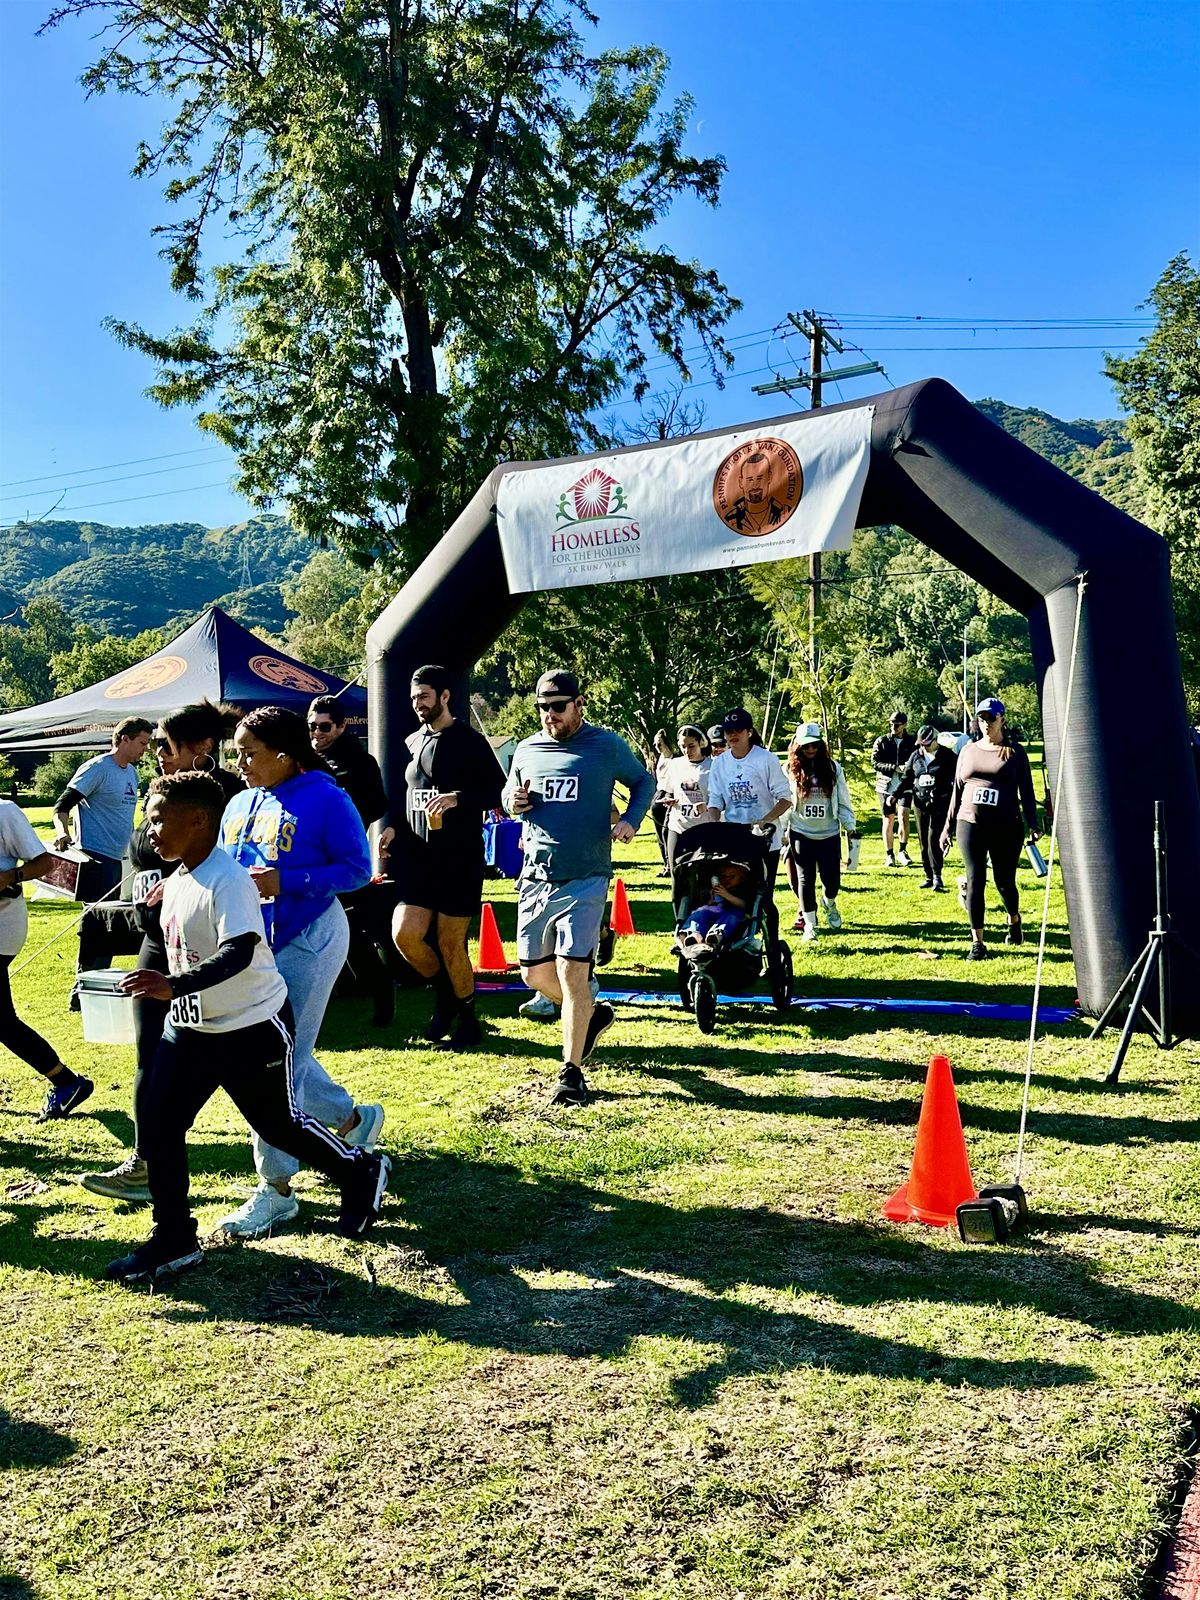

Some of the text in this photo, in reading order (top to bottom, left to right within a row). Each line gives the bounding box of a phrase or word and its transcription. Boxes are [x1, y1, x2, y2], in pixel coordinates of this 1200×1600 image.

[718, 472, 728, 510] PENNIES
[775, 446, 796, 501] FOUNDATION
[552, 522, 640, 552] HOMELESS
[552, 543, 640, 564] FOR THE HOLIDAYS
[545, 779, 576, 799] 572
[976, 789, 996, 804] 591
[805, 805, 825, 817] 595
[172, 994, 200, 1023] 585
